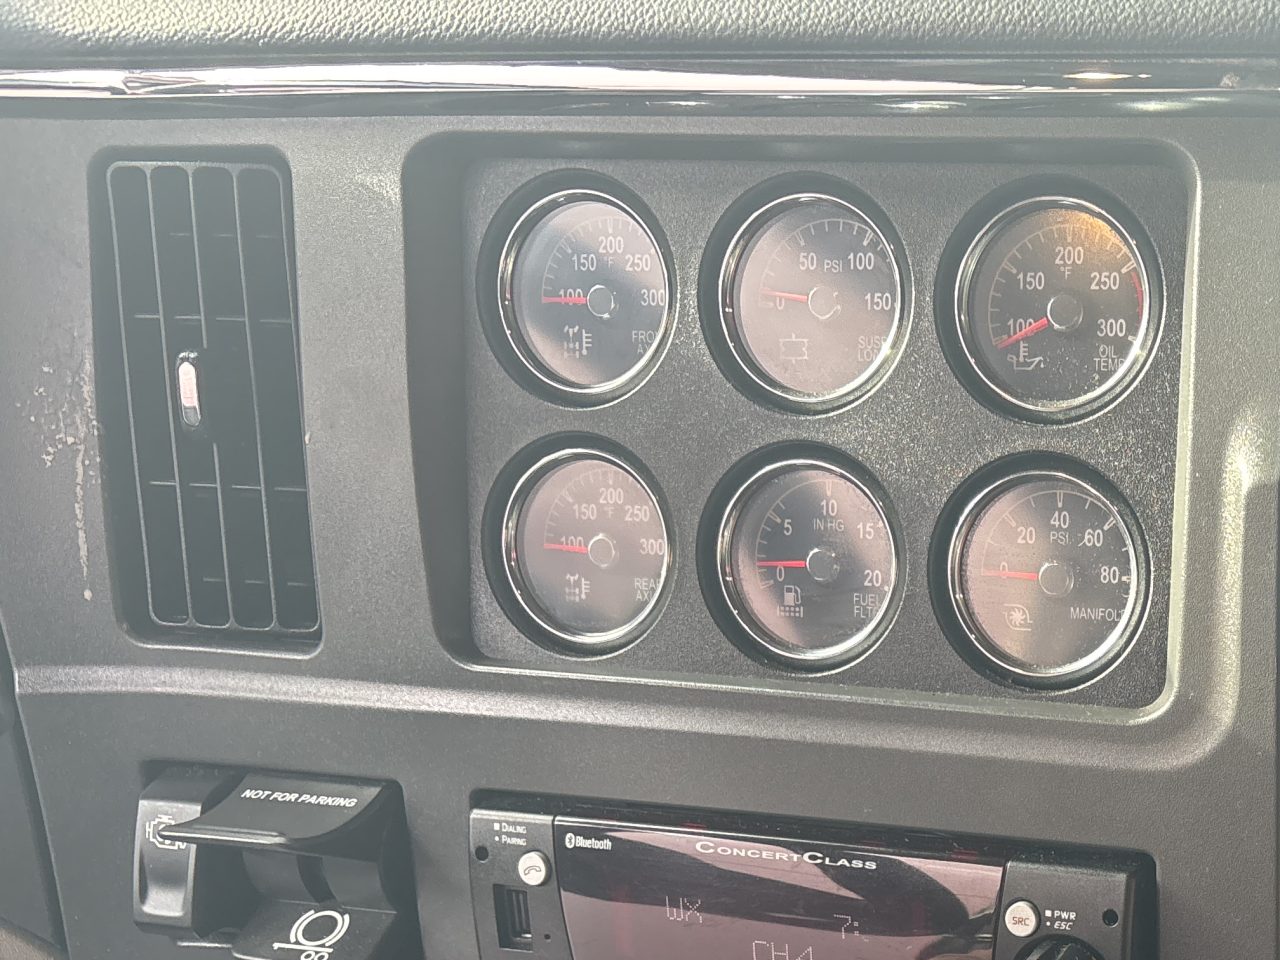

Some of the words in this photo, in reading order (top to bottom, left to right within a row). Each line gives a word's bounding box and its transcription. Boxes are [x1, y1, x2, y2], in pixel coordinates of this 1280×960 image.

[598, 236, 624, 253] 200
[572, 254, 597, 271] 150
[625, 254, 651, 271] 250
[799, 253, 817, 270] 50
[848, 253, 874, 270] 100
[1055, 246, 1084, 265] 200
[824, 260, 842, 273] PSI
[1017, 272, 1045, 290] 150
[1090, 272, 1120, 291] 250
[559, 289, 584, 305] 100
[640, 289, 665, 306] 300
[865, 293, 891, 311] 150
[1007, 318, 1035, 336] 100
[1097, 318, 1126, 337] 300
[1099, 344, 1117, 358] OIL
[599, 488, 624, 505] 200
[573, 505, 597, 521] 150
[625, 506, 650, 522] 250
[820, 500, 837, 517] 10
[783, 520, 793, 536] 5
[813, 519, 825, 531] IN
[827, 519, 844, 532] HG
[1051, 511, 1069, 529] 40
[857, 523, 874, 540] 15
[1017, 527, 1036, 544] 20
[1085, 529, 1103, 547] 60
[640, 539, 665, 556] 300
[776, 566, 785, 582] 0
[864, 570, 882, 587] 20
[1100, 567, 1119, 584] 80
[241, 789, 271, 800] NOT
[270, 791, 297, 803] FOR
[297, 793, 358, 808] PARKING
[575, 835, 612, 851] Bluetooth
[666, 895, 703, 924] WX
[1054, 910, 1076, 921] PWR
[1012, 916, 1030, 927] SRC
[1053, 920, 1074, 931] ESC
